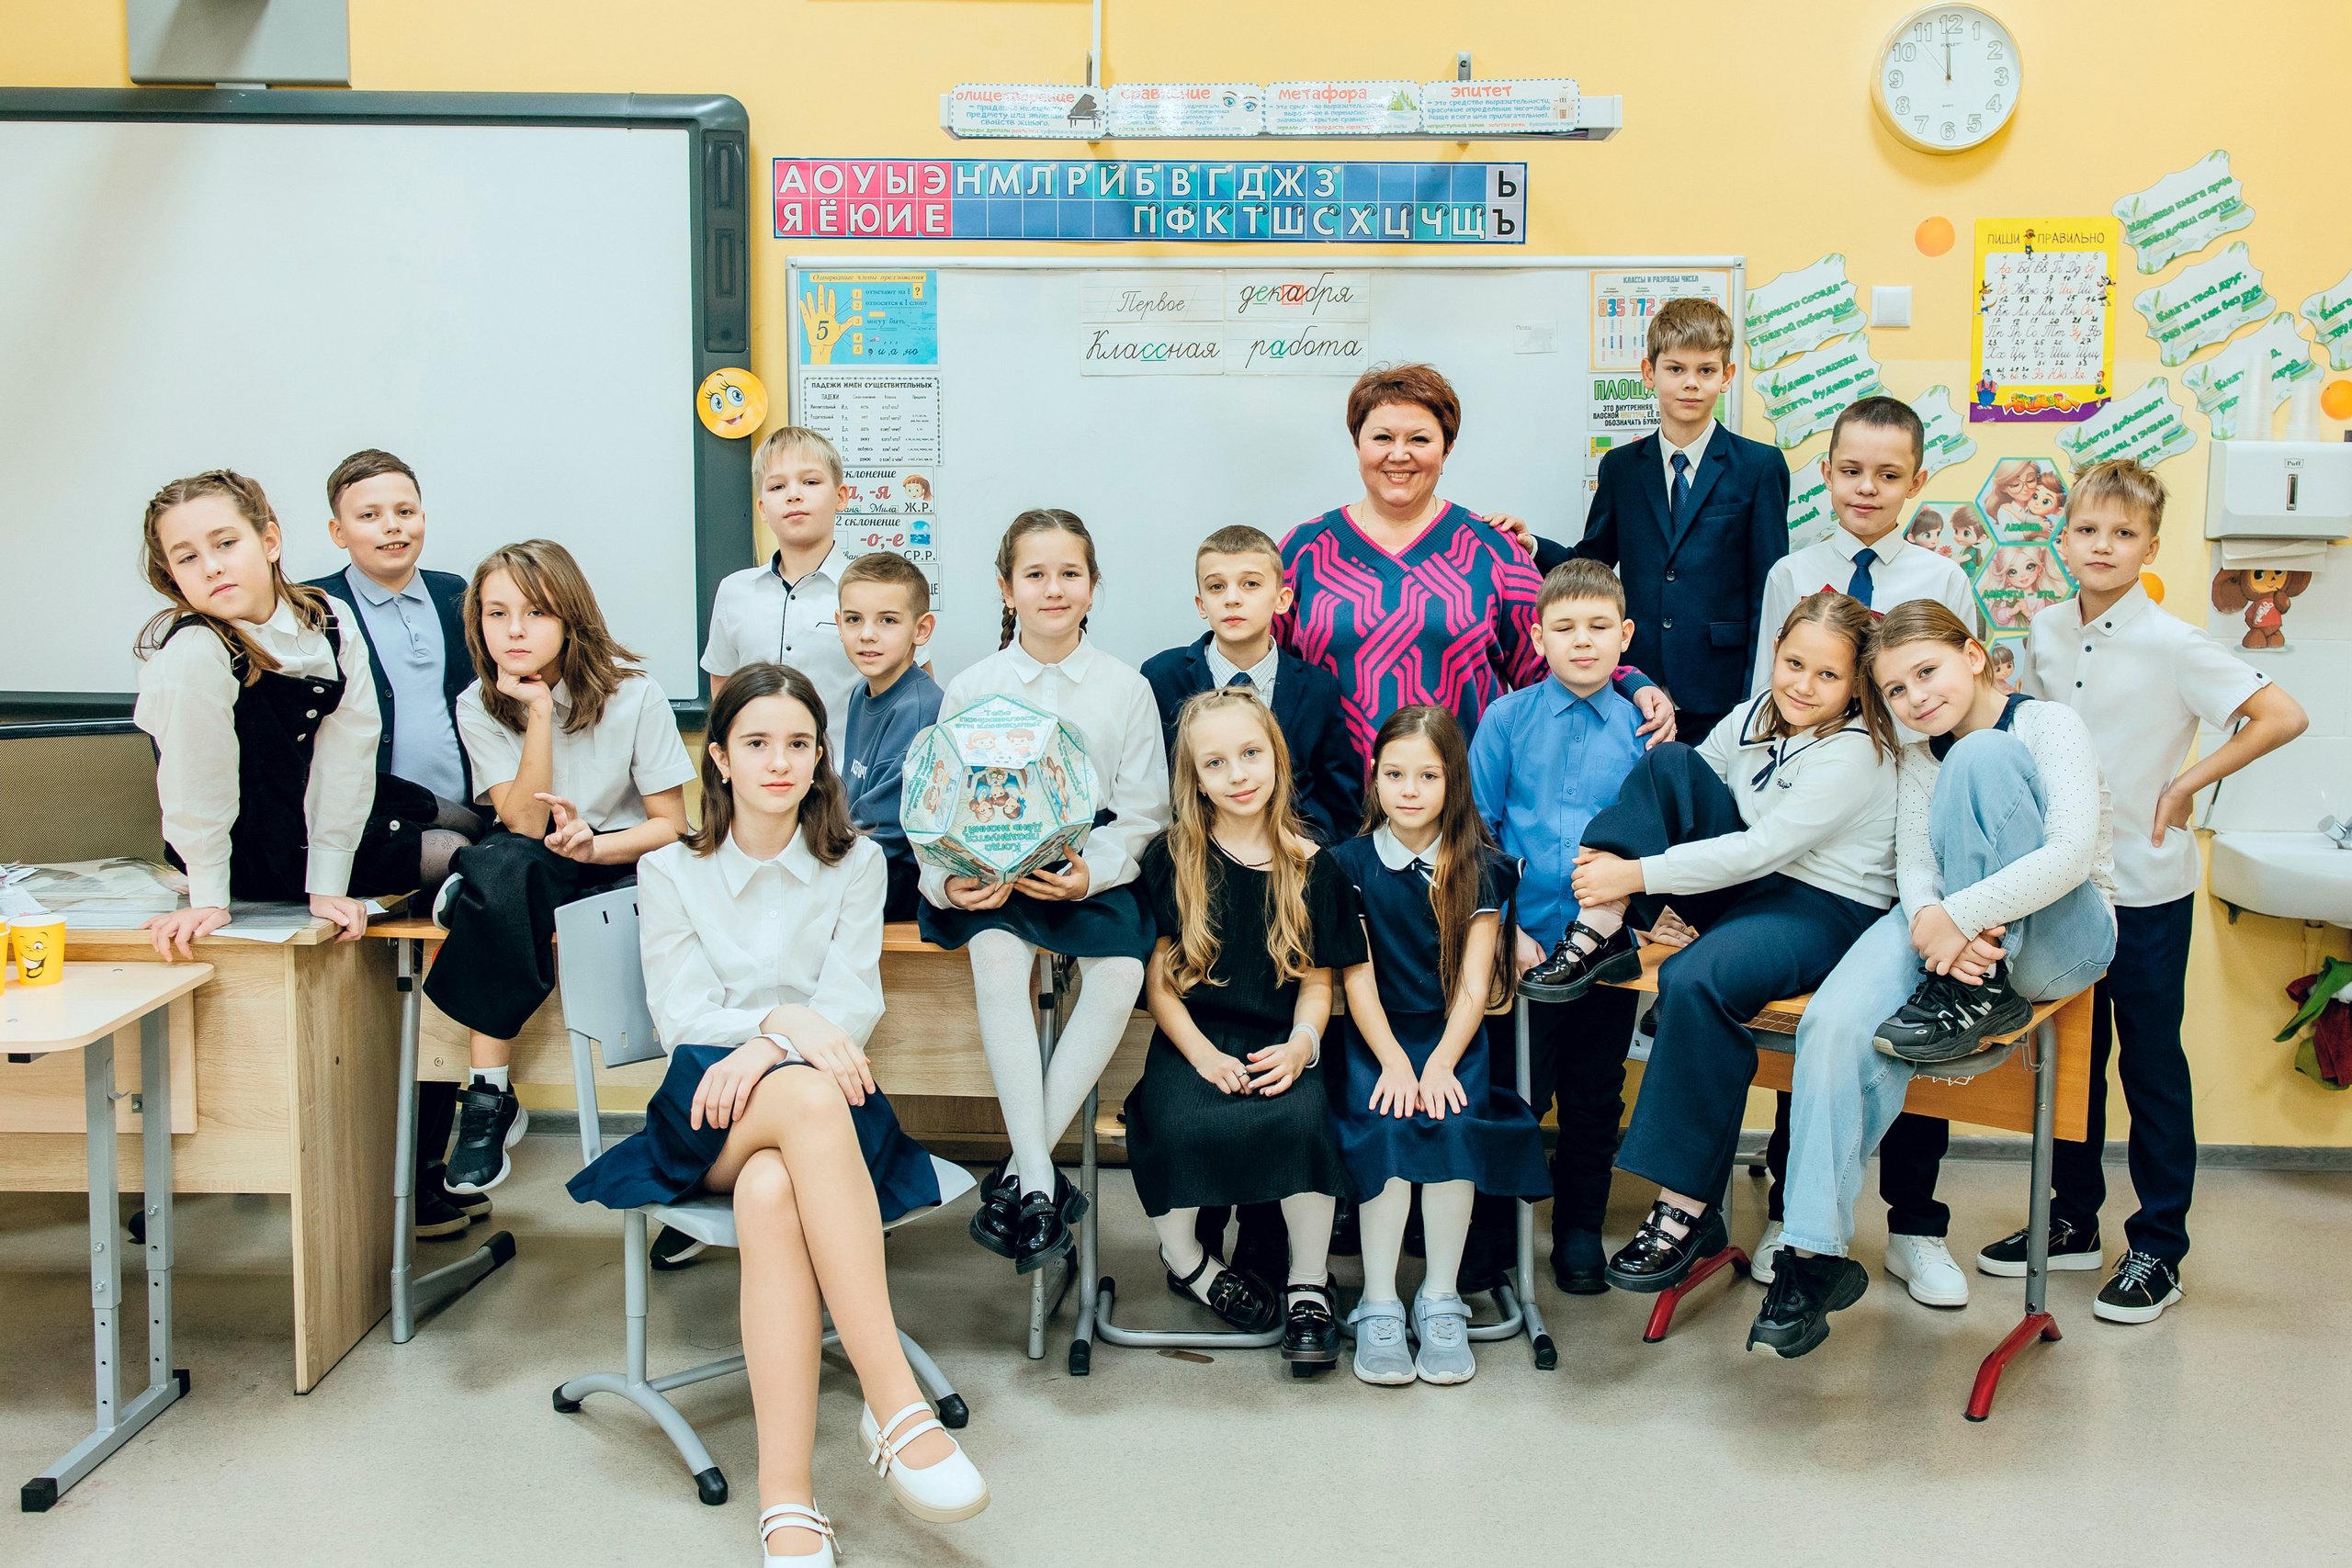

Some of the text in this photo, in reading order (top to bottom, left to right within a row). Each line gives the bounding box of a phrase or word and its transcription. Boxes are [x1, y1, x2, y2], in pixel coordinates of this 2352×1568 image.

[1914, 22, 1933, 42] 11
[1939, 14, 1963, 35] 12
[1972, 20, 1981, 40] 1
[1892, 42, 1917, 62] 10
[1986, 40, 2004, 60] 2
[1888, 69, 1904, 89] 9
[1994, 66, 2009, 86] 3
[1278, 84, 1367, 104] метафора
[1451, 85, 1512, 97] эпитет
[1427, 106, 1464, 114] красочное
[1485, 98, 1551, 107] выразительности,
[1894, 96, 1910, 116] 8
[1985, 94, 2003, 113] 4
[967, 111, 1007, 119] предмету
[1428, 113, 1449, 121] (чаще
[1488, 111, 1549, 120] прилагательное).
[1914, 115, 1930, 134] 7
[1966, 113, 1983, 133] 5
[1940, 121, 1956, 141] 6
[778, 164, 1516, 201] А О У Ы Э Н М Л Р Й Б В Г Д Ж З Ь
[2127, 176, 2233, 233] Хорошая книга ярче
[2198, 196, 2236, 220] светит
[782, 199, 1516, 240] Я Ё Ю И Е П Ф К Т Ш С Х Ц Ч Щ Ъ
[1987, 232, 2105, 244] ПИШИ ПРАВИЛЬНО
[1116, 272, 1353, 321] Первое декабря
[1764, 283, 1841, 323] умного соседа
[2155, 301, 2190, 322] Книга
[2189, 286, 2218, 304] твой
[1598, 299, 1625, 317] 835
[2161, 325, 2181, 343] без
[2200, 306, 2222, 321] как
[2222, 295, 2241, 310] без
[2241, 284, 2262, 304] рук
[816, 321, 830, 341] 5
[1750, 298, 1855, 347] с книгой побеседуй
[1086, 326, 1363, 369] Классная работа
[1815, 354, 1859, 378] книжки
[1594, 378, 1658, 400] ПЛОЩА
[1812, 378, 1854, 400] будешь
[1593, 412, 1619, 420] ПЛОСКОЙ
[1616, 404, 1653, 412] ВНУТРЕННЯЯ
[1815, 402, 1846, 420] знать
[2071, 428, 2110, 454] Золото
[2111, 396, 2165, 434] добывают
[2131, 434, 2139, 443] а
[2138, 413, 2175, 438] знания
[2287, 459, 2301, 468] Puff
[869, 502, 933, 513] Мила Ж.Р.
[835, 515, 901, 527] 2 склонение
[2004, 523, 2043, 533] ЛЮБОВЬ
[903, 550, 936, 560] СР.Р.
[1982, 589, 2025, 599] ДОБРОТА
[959, 715, 1038, 725] понравились
[985, 709, 1012, 717] Тебе
[955, 721, 976, 729] эти
[962, 821, 1043, 836] День знаний?
[966, 832, 1041, 843] празднуется
[985, 842, 1022, 853] Когда
